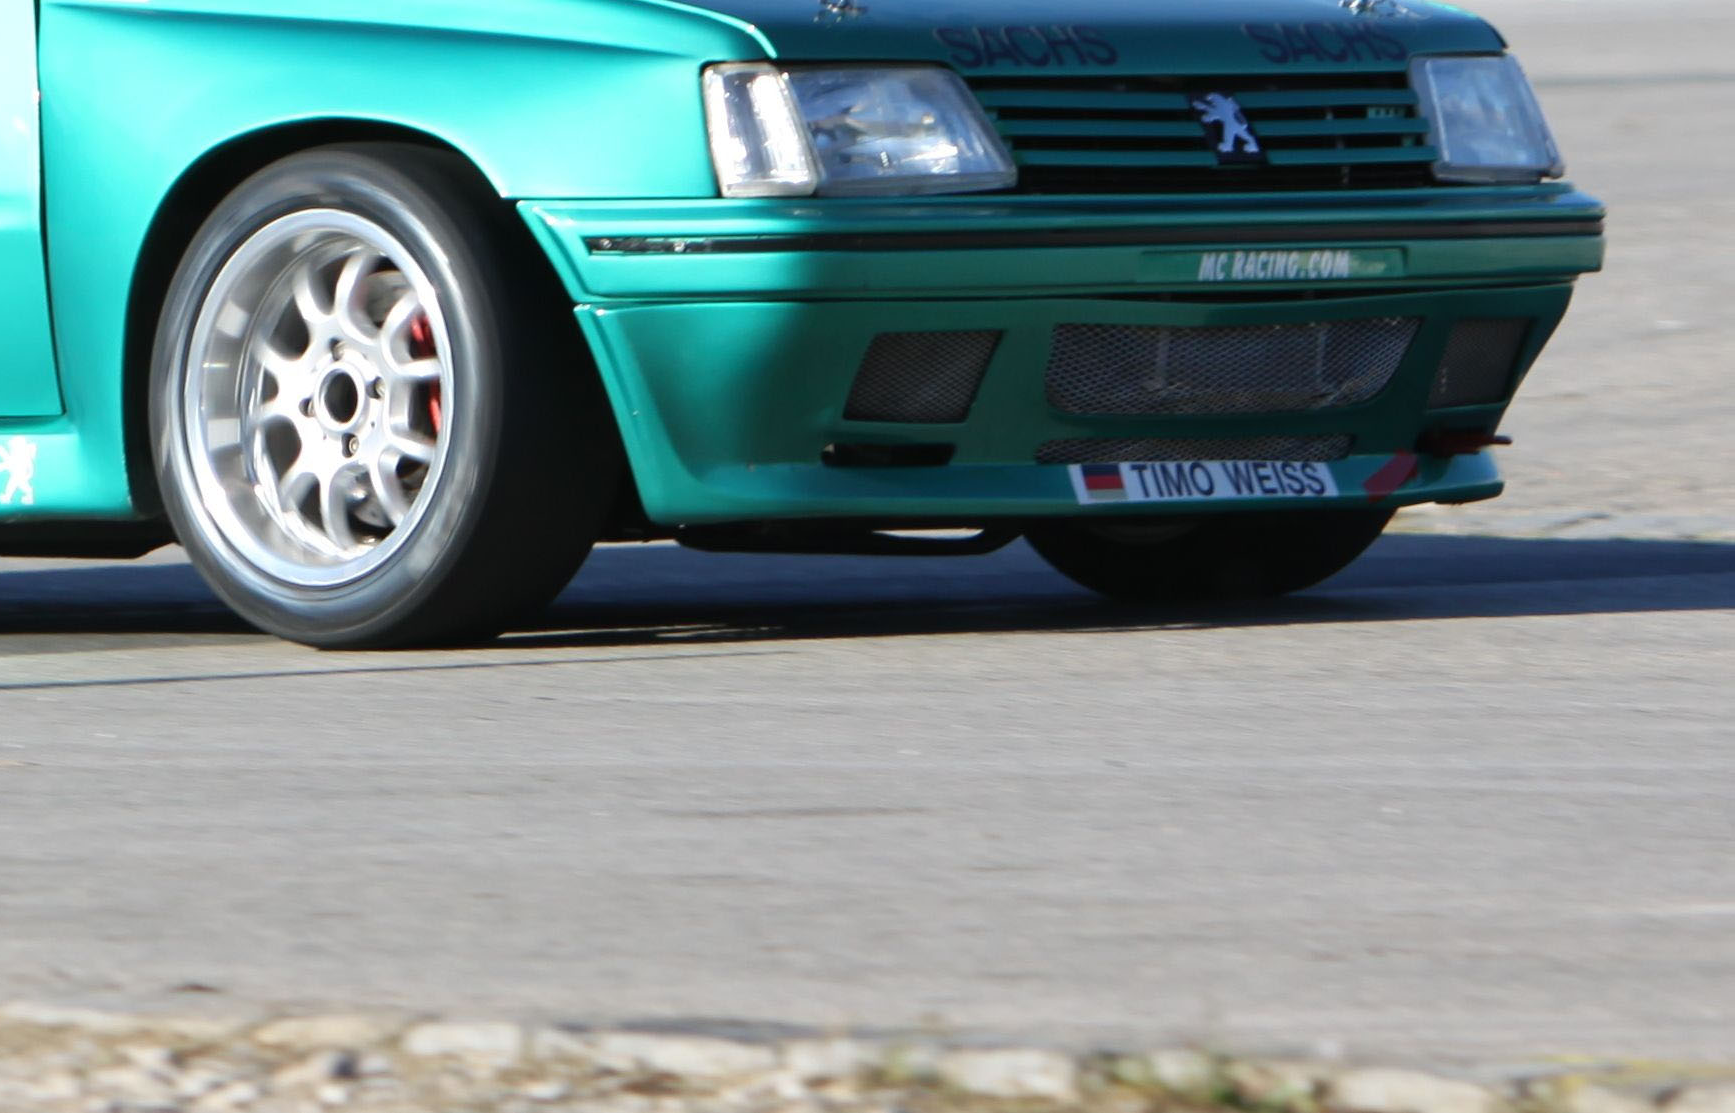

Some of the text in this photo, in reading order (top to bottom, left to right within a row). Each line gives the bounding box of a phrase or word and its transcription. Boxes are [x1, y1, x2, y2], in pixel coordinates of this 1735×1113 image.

[933, 25, 1120, 68] SACHS
[1240, 22, 1409, 64] SACHS
[1198, 251, 1351, 281] MC RACING.COM
[1131, 461, 1327, 498] TIMO WEISS
